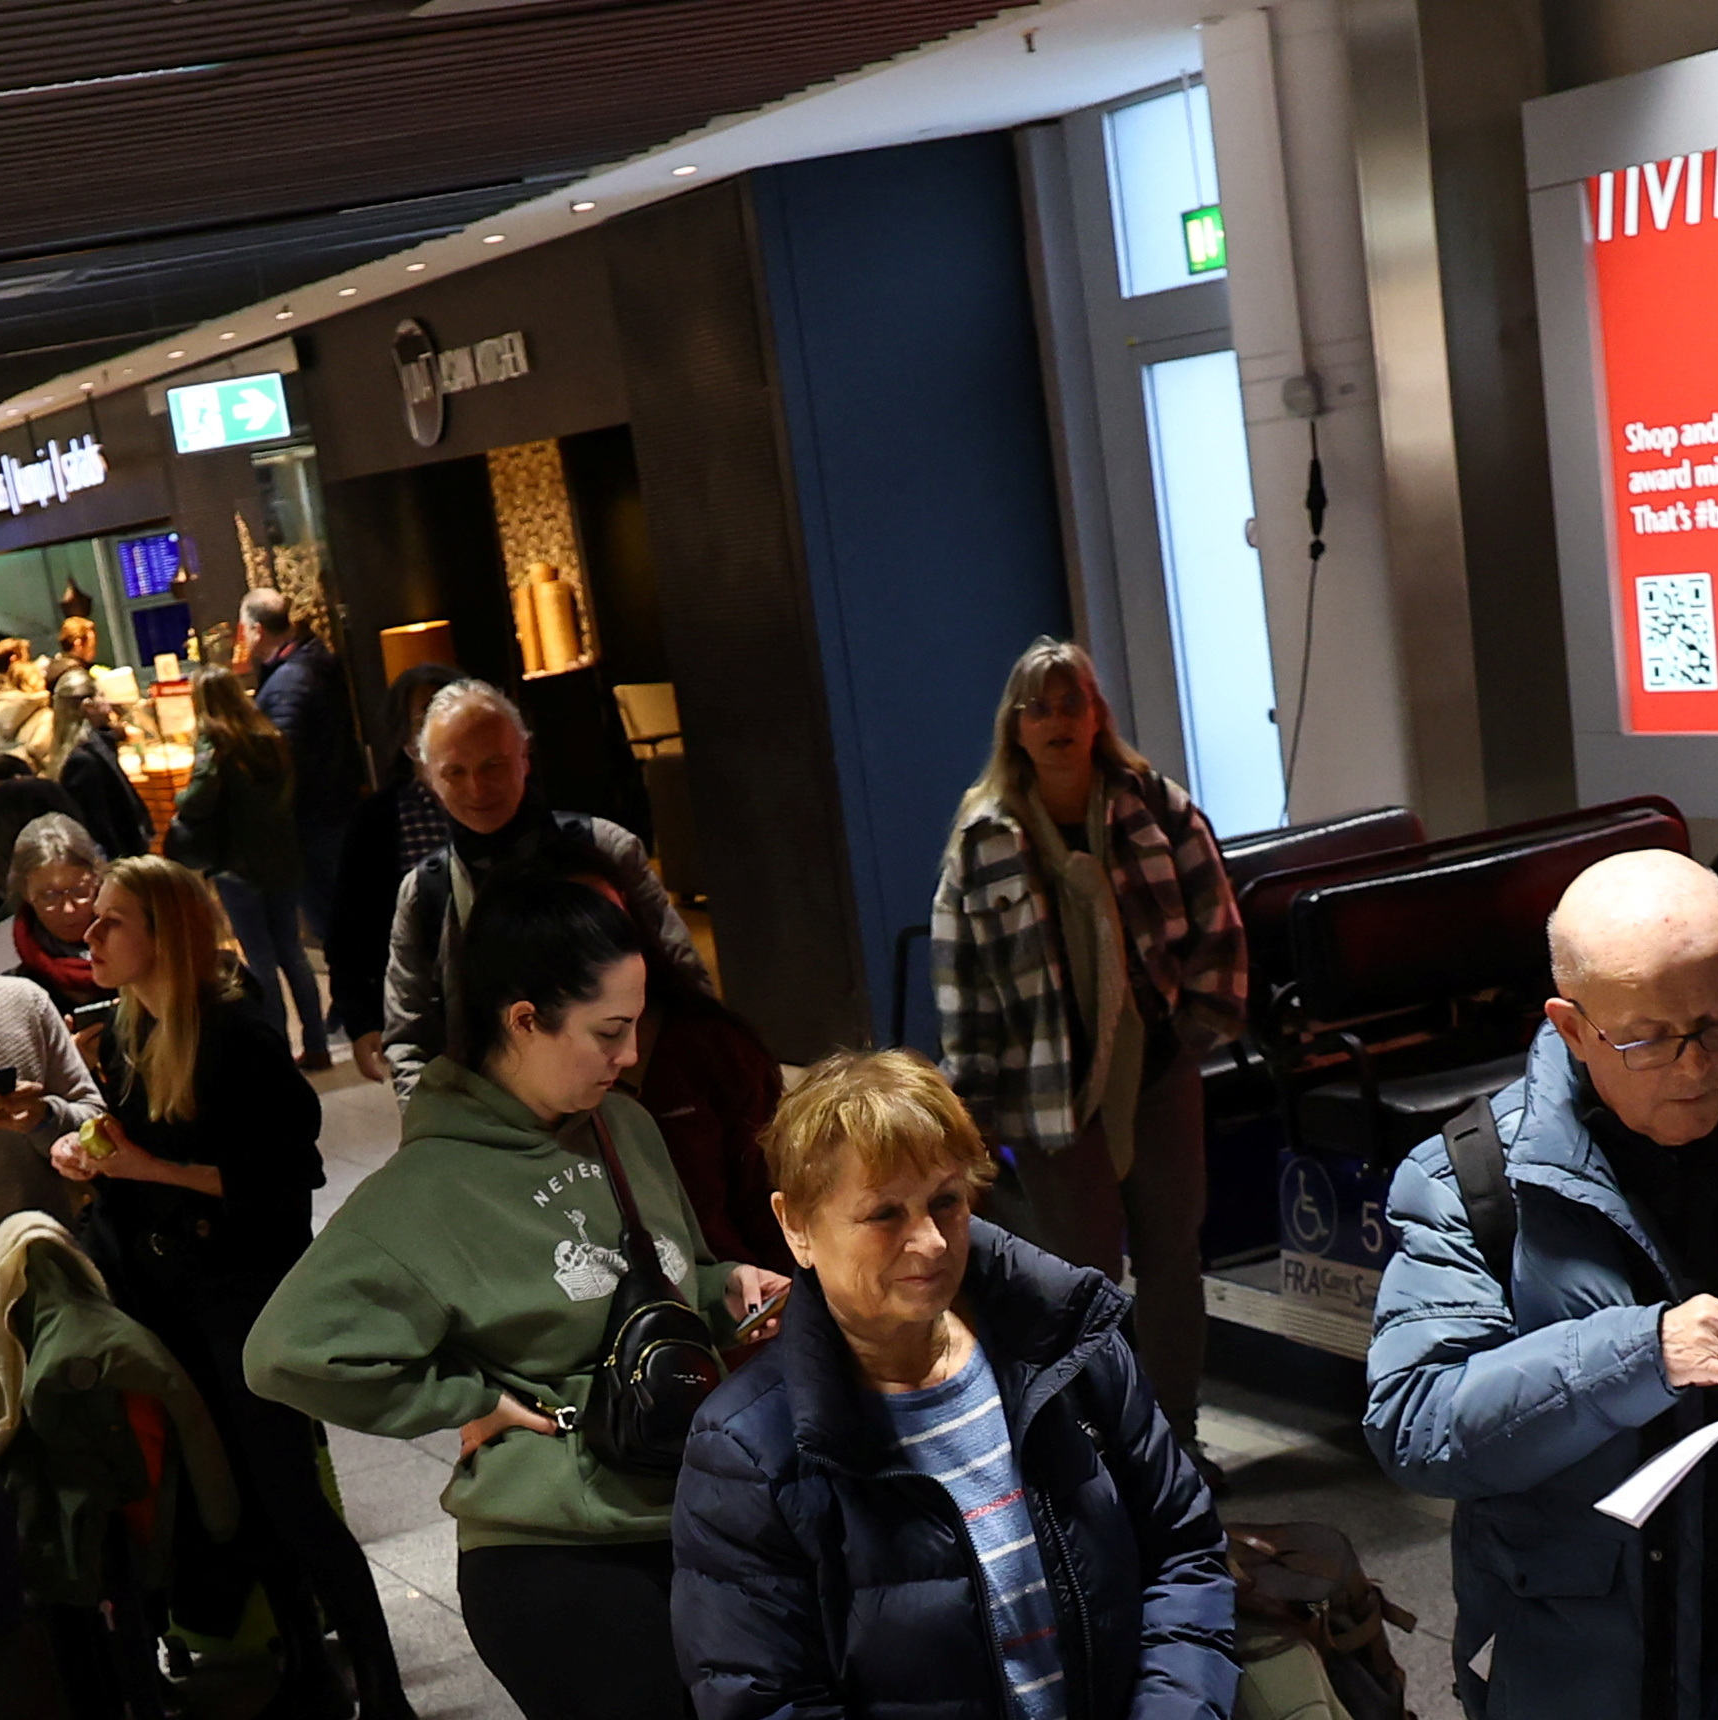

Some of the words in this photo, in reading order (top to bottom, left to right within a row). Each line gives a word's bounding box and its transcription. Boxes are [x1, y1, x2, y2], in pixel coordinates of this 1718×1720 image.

[1623, 421, 1679, 457] Shop
[1628, 459, 1692, 494] award
[1629, 501, 1693, 535] That's
[532, 1161, 603, 1208] NEVER
[1361, 1201, 1383, 1254] 5
